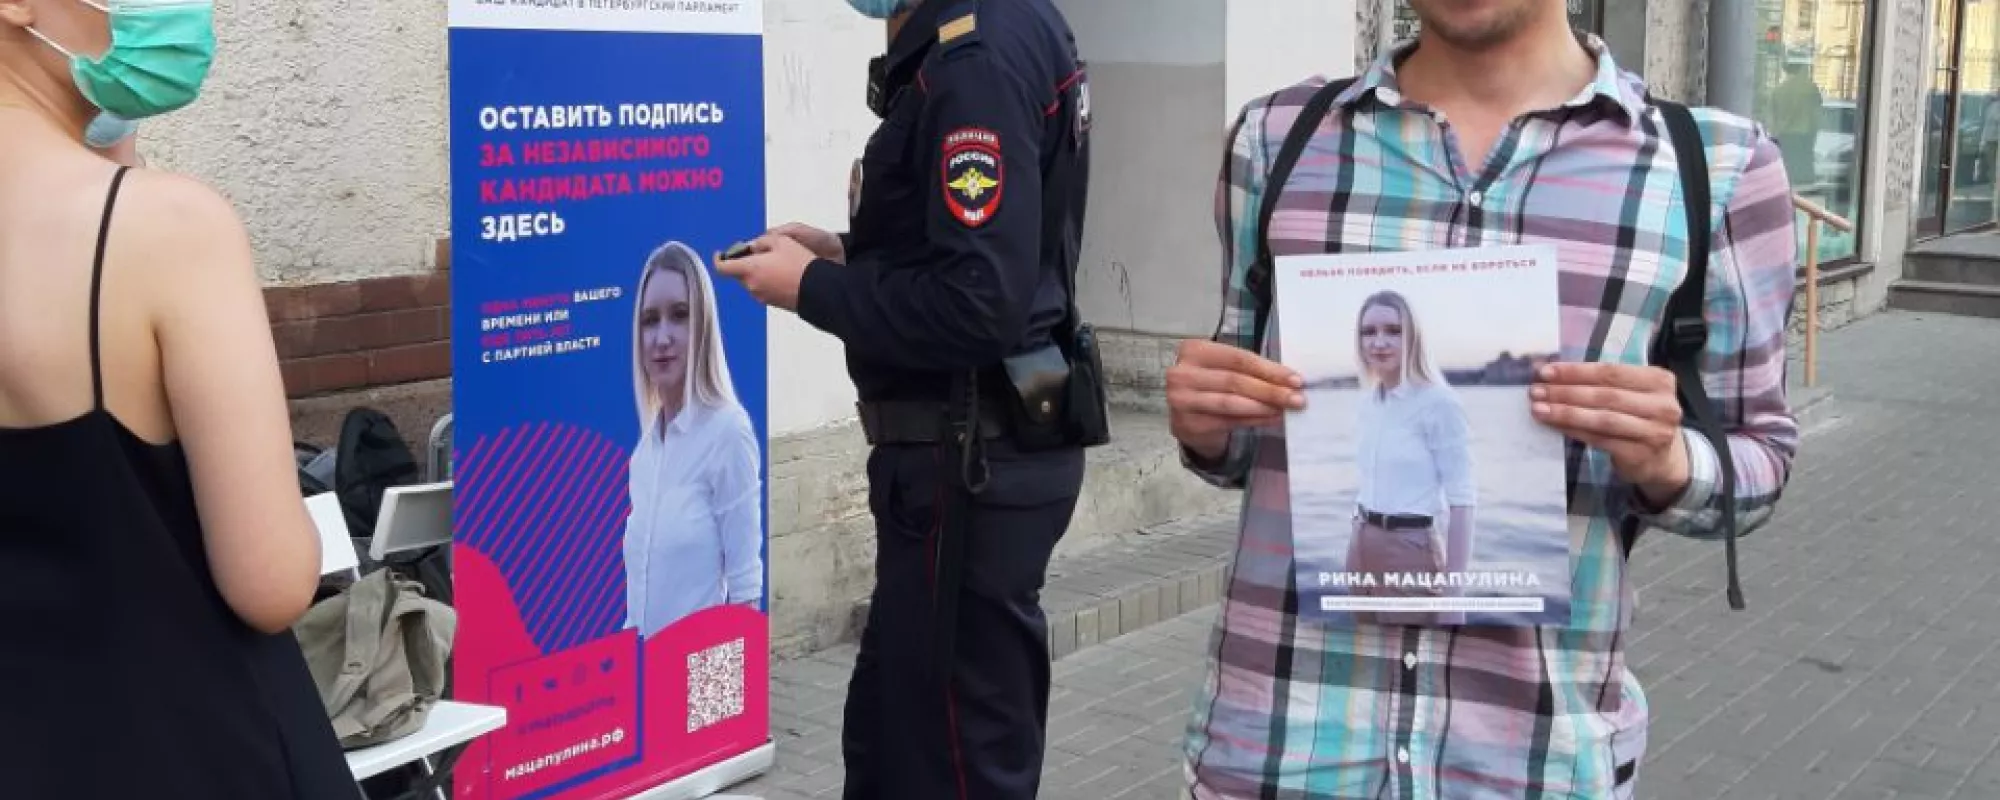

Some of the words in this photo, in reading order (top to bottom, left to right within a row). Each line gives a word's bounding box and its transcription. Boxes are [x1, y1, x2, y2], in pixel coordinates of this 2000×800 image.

[479, 104, 613, 130] ОСТАВИТЬ
[618, 102, 724, 129] ПОДПИСЬ
[479, 143, 515, 167] ЗА
[523, 135, 710, 164] НЕЗАВИСИМОГО
[949, 152, 996, 168] РОССИЯ
[479, 172, 632, 203] КАНДИДАТА
[639, 167, 723, 193] МОЖНО
[480, 210, 566, 241] ЗДЕСЬ
[1451, 262, 1467, 271] НЕ
[573, 286, 622, 303] ВАШЕГО
[481, 312, 541, 331] ВРЕМЕНИ
[545, 309, 570, 324] ИЛИ
[481, 350, 491, 363] С
[495, 341, 553, 361] ПАРТИЕЙ
[555, 337, 600, 353] ВЛАСТИ
[1318, 571, 1377, 587] РИНА
[1383, 571, 1541, 588] МАЦАПУЛИНА
[505, 727, 625, 780] мацапулина.рф
